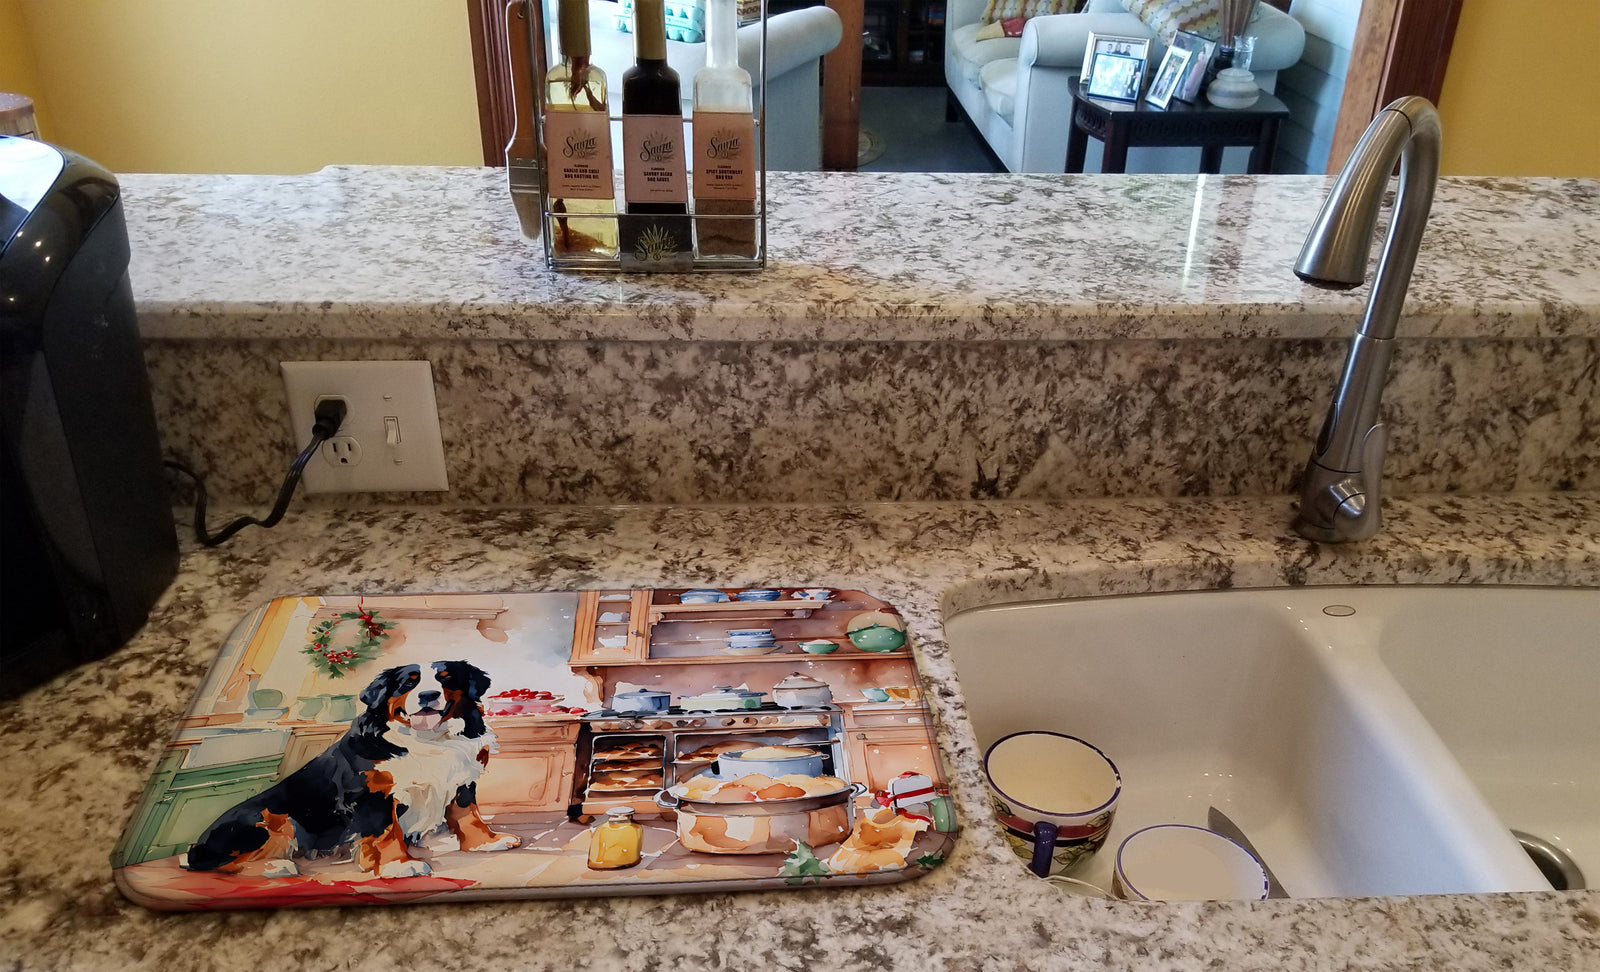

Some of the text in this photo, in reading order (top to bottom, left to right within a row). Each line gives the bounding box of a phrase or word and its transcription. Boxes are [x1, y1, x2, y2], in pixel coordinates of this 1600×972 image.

[563, 136, 597, 158] Sauza
[640, 140, 673, 162] Sauza
[707, 137, 739, 159] Sauza
